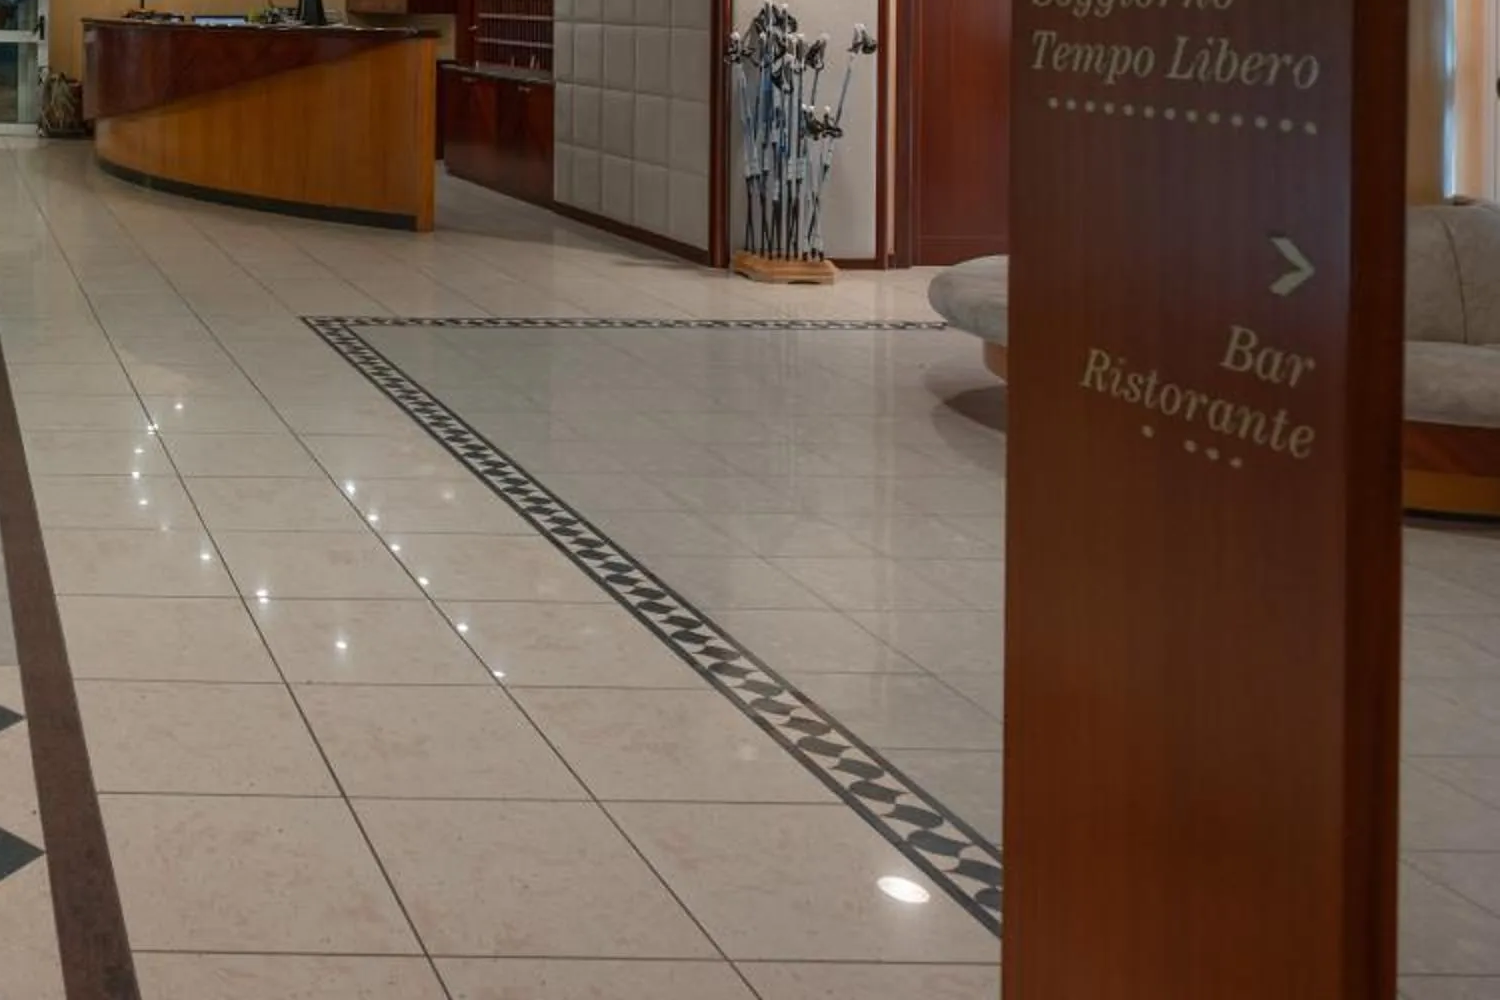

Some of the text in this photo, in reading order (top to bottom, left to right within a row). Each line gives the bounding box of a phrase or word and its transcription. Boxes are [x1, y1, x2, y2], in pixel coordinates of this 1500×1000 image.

[1031, 30, 1320, 90] Tempo Libero
[1221, 325, 1316, 388] Bar
[1080, 348, 1315, 460] Ristorante
